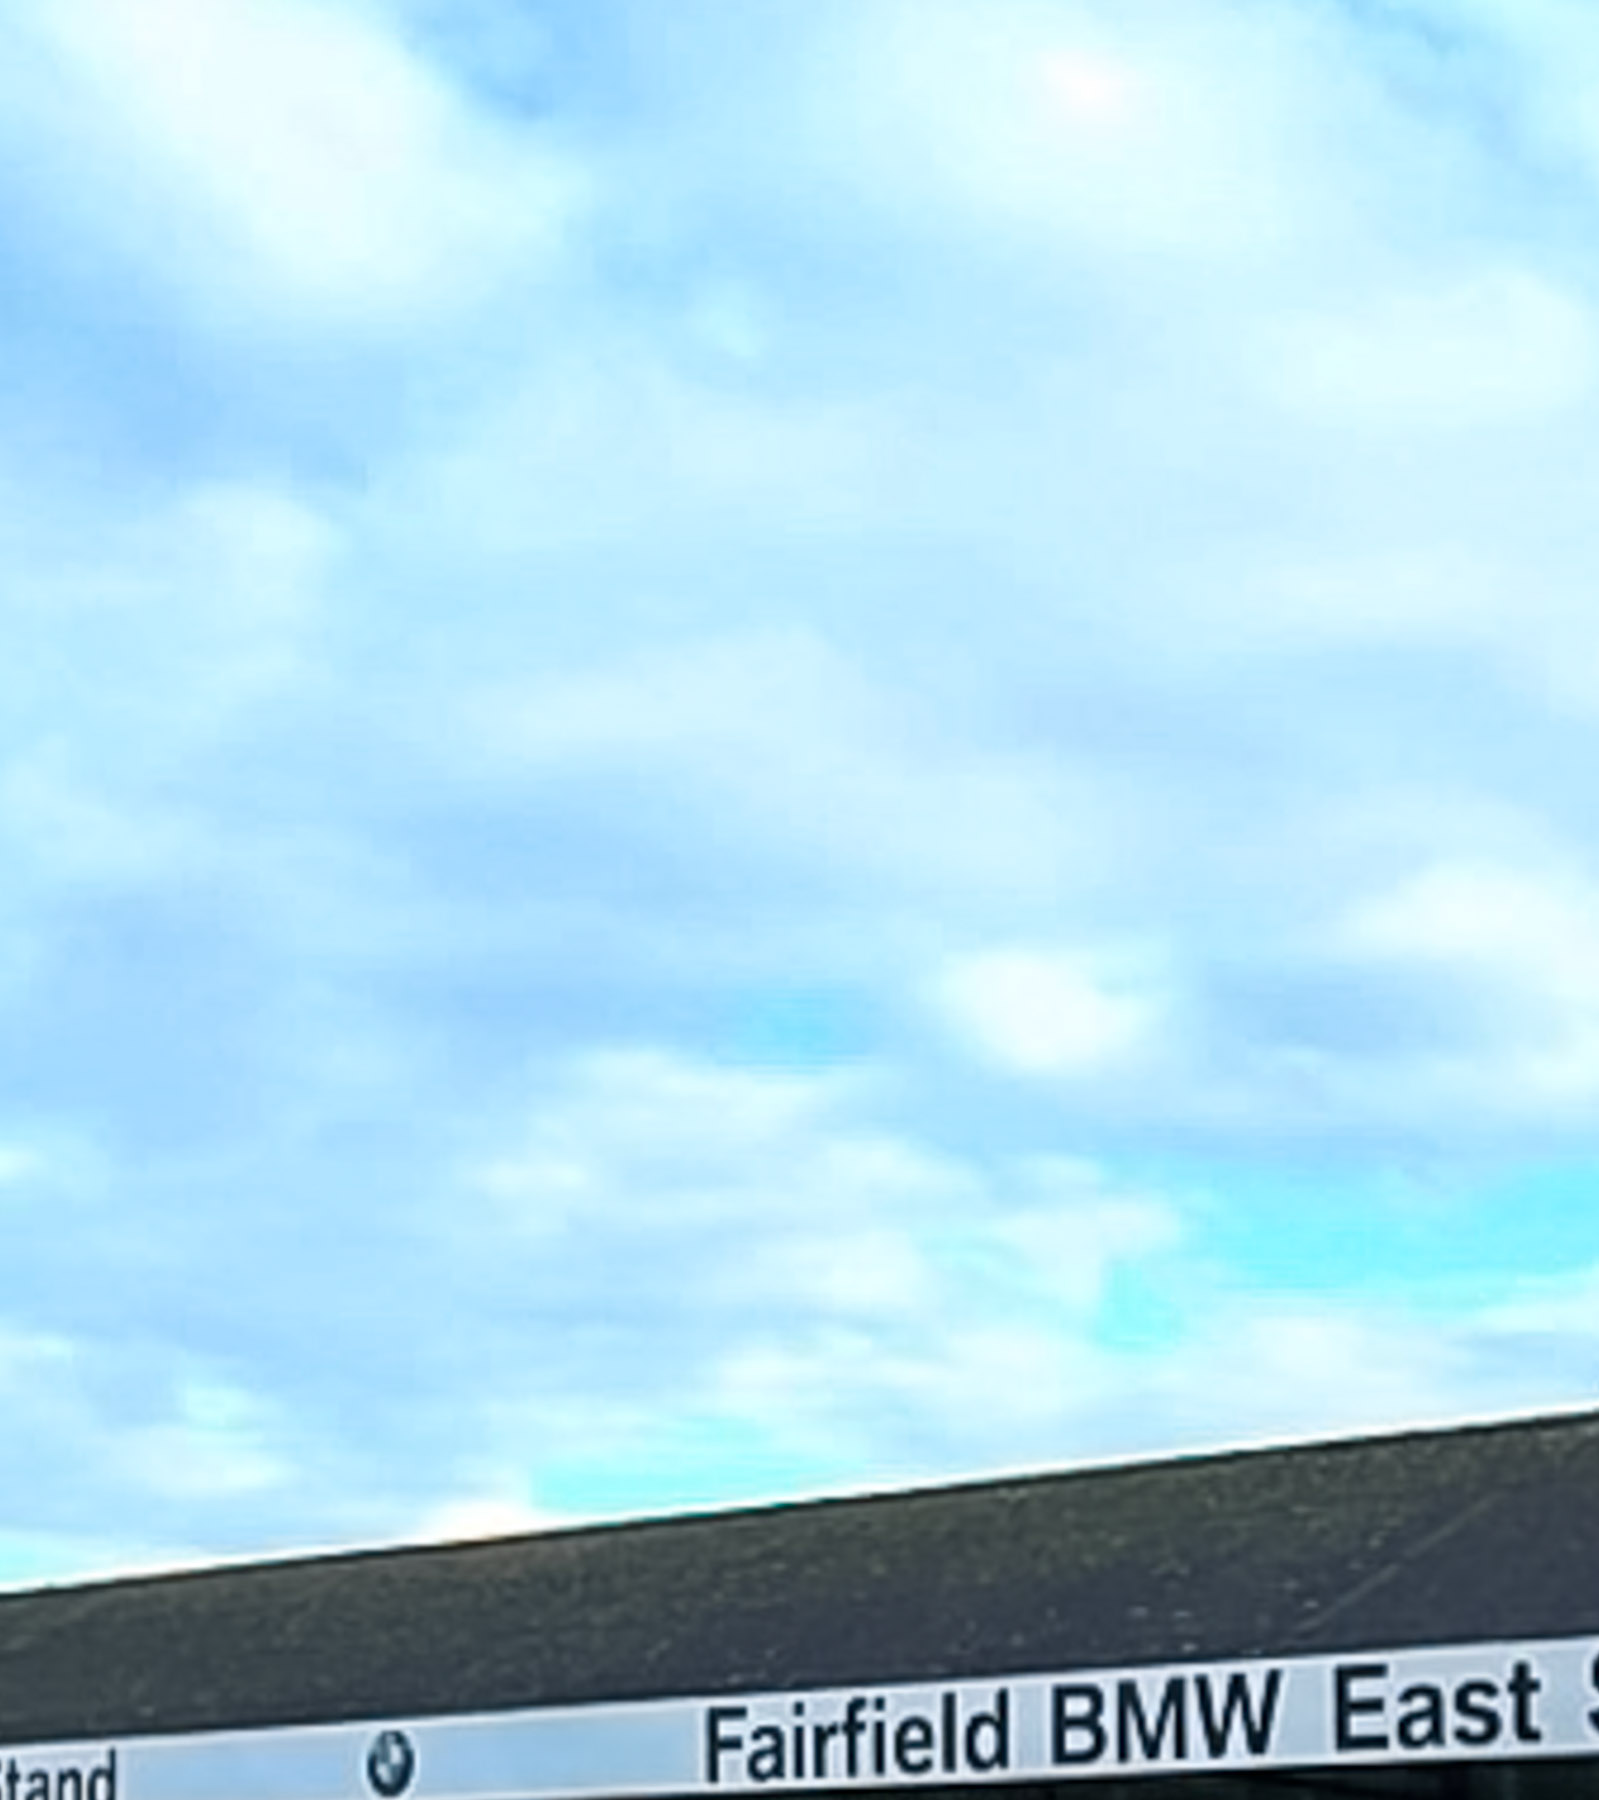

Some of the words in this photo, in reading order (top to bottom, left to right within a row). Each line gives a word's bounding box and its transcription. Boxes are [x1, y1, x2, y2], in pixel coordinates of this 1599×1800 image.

[705, 1686, 1010, 1785] Fairfield
[1051, 1668, 1282, 1766] BMW
[1334, 1660, 1542, 1753] East
